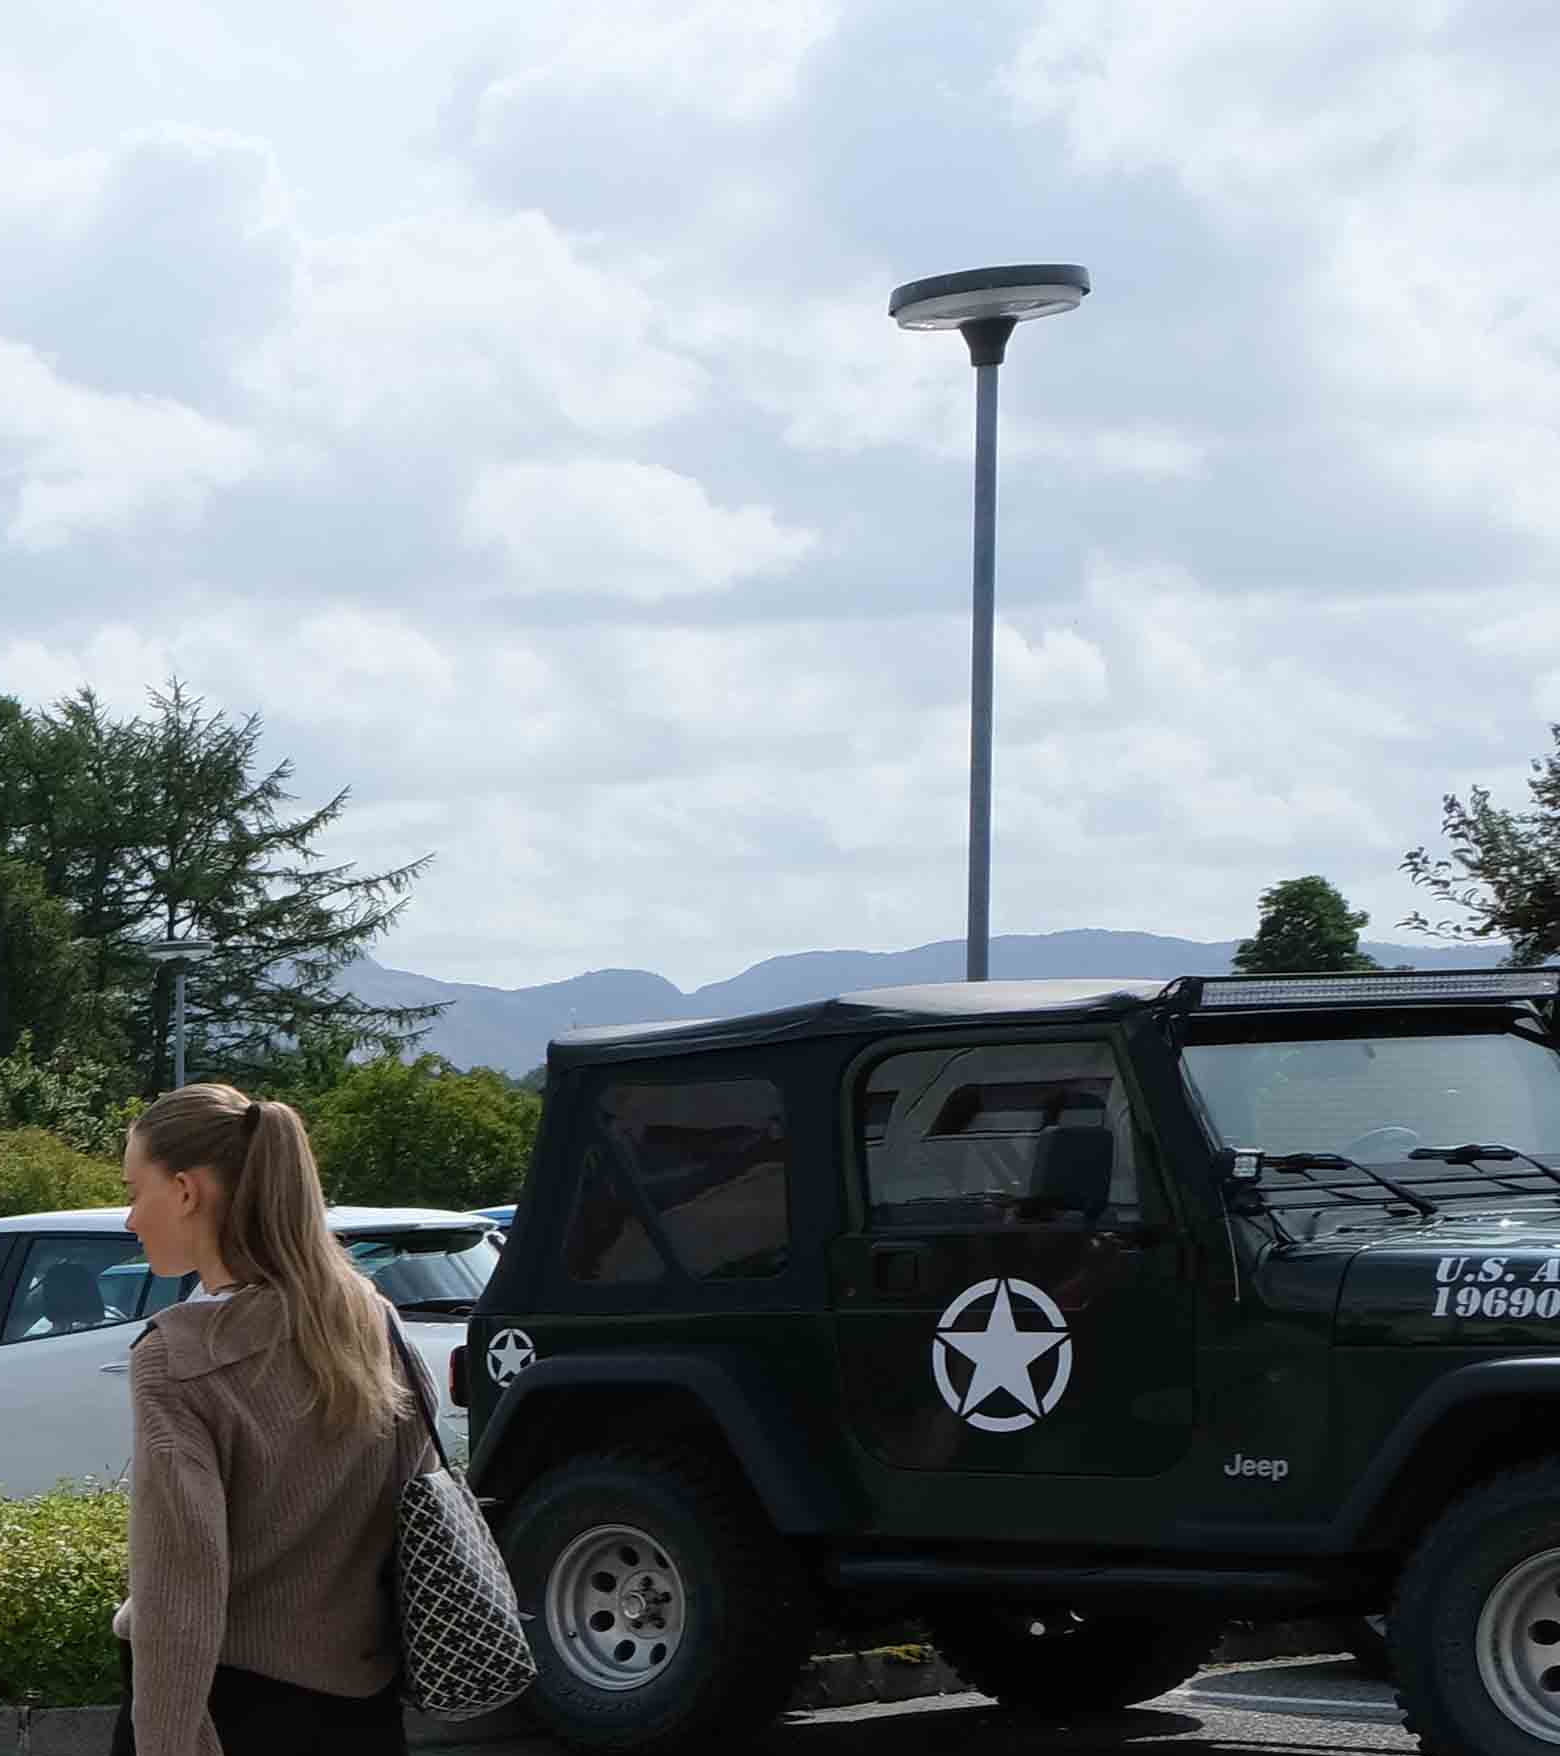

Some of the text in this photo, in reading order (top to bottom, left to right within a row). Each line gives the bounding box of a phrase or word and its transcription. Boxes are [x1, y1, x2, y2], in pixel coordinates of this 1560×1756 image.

[1435, 1256, 1516, 1283] U.S.
[1431, 1286, 1560, 1319] 19690
[1223, 1453, 1289, 1481] Jeep
